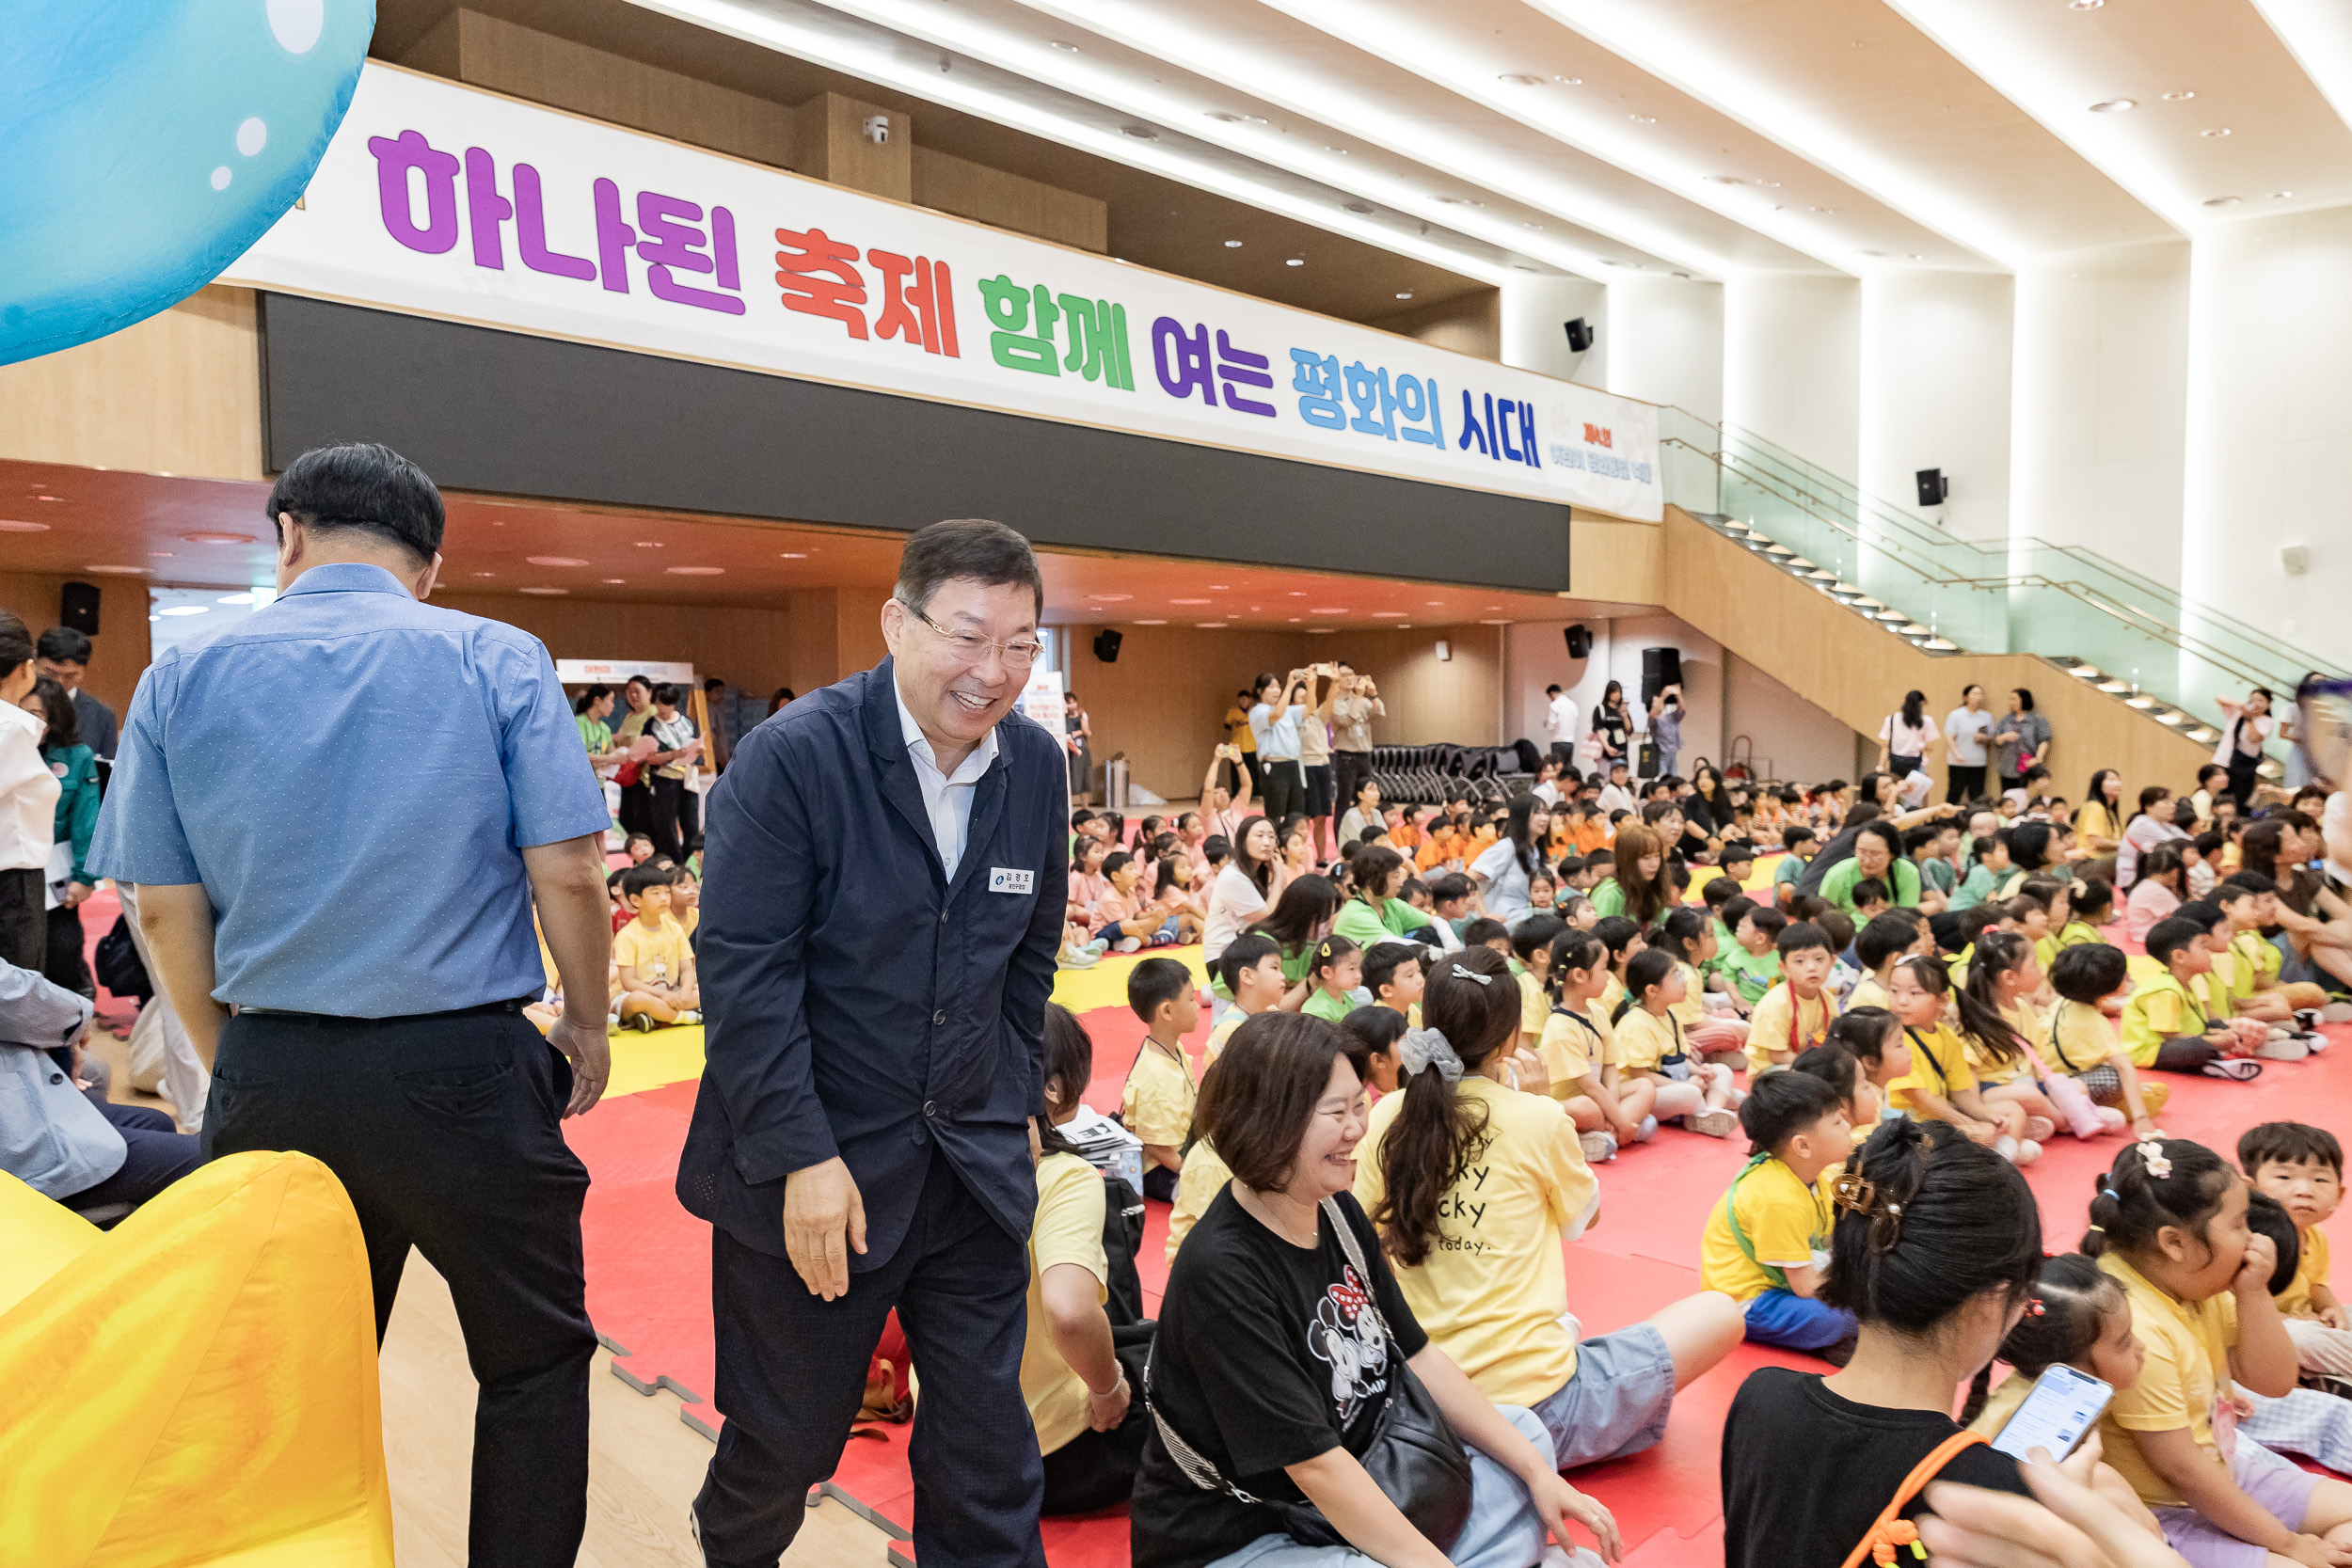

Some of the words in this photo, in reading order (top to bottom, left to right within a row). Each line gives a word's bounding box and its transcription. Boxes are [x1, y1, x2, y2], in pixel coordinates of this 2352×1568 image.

[368, 130, 745, 315] 하나된
[775, 228, 961, 358] 축제
[978, 275, 1135, 391] 함께
[1152, 316, 1277, 418] 여는
[1289, 347, 1446, 450] 평화의
[1458, 389, 1541, 468] 시대
[1438, 1236, 1491, 1256] today.
